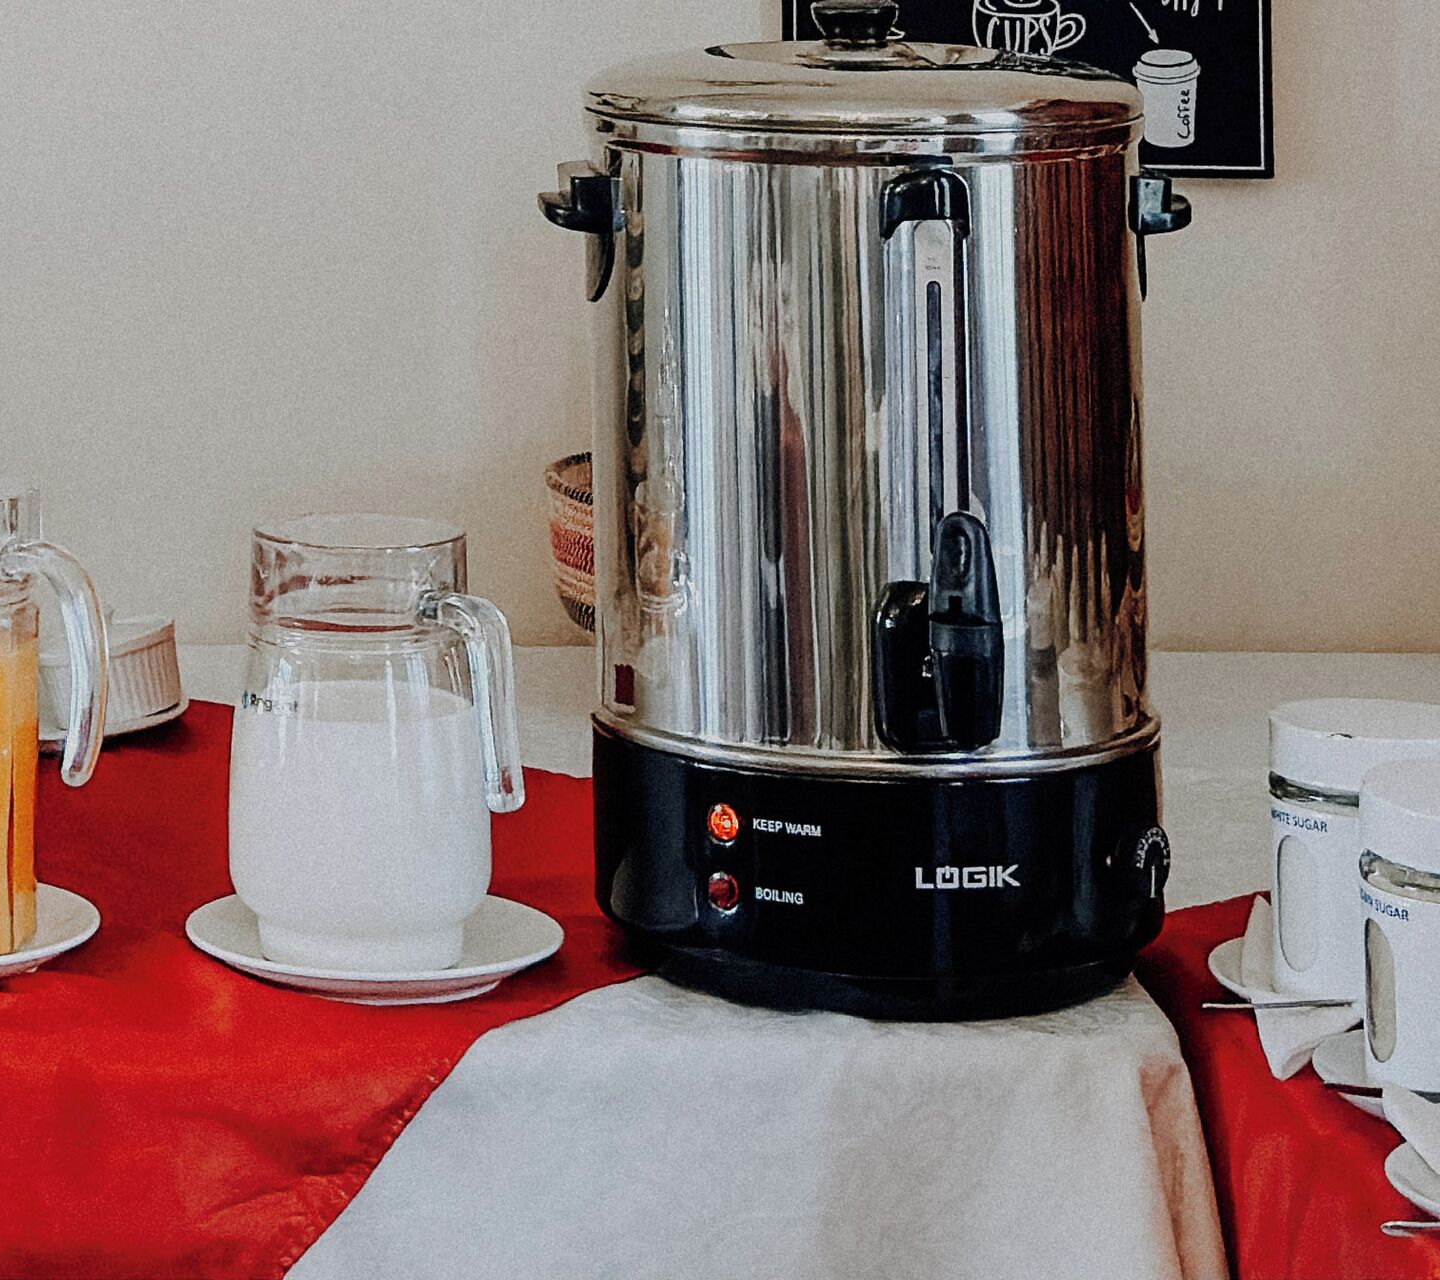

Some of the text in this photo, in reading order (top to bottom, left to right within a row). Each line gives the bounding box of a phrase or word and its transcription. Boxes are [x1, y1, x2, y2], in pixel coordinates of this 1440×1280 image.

[1177, 89, 1190, 139] Coffee
[752, 817, 822, 837] KEEP WARM
[1292, 816, 1328, 833] SUGAR
[914, 863, 1021, 891] LOGIK
[755, 887, 804, 905] BOILING
[1374, 898, 1409, 921] SUGAR
